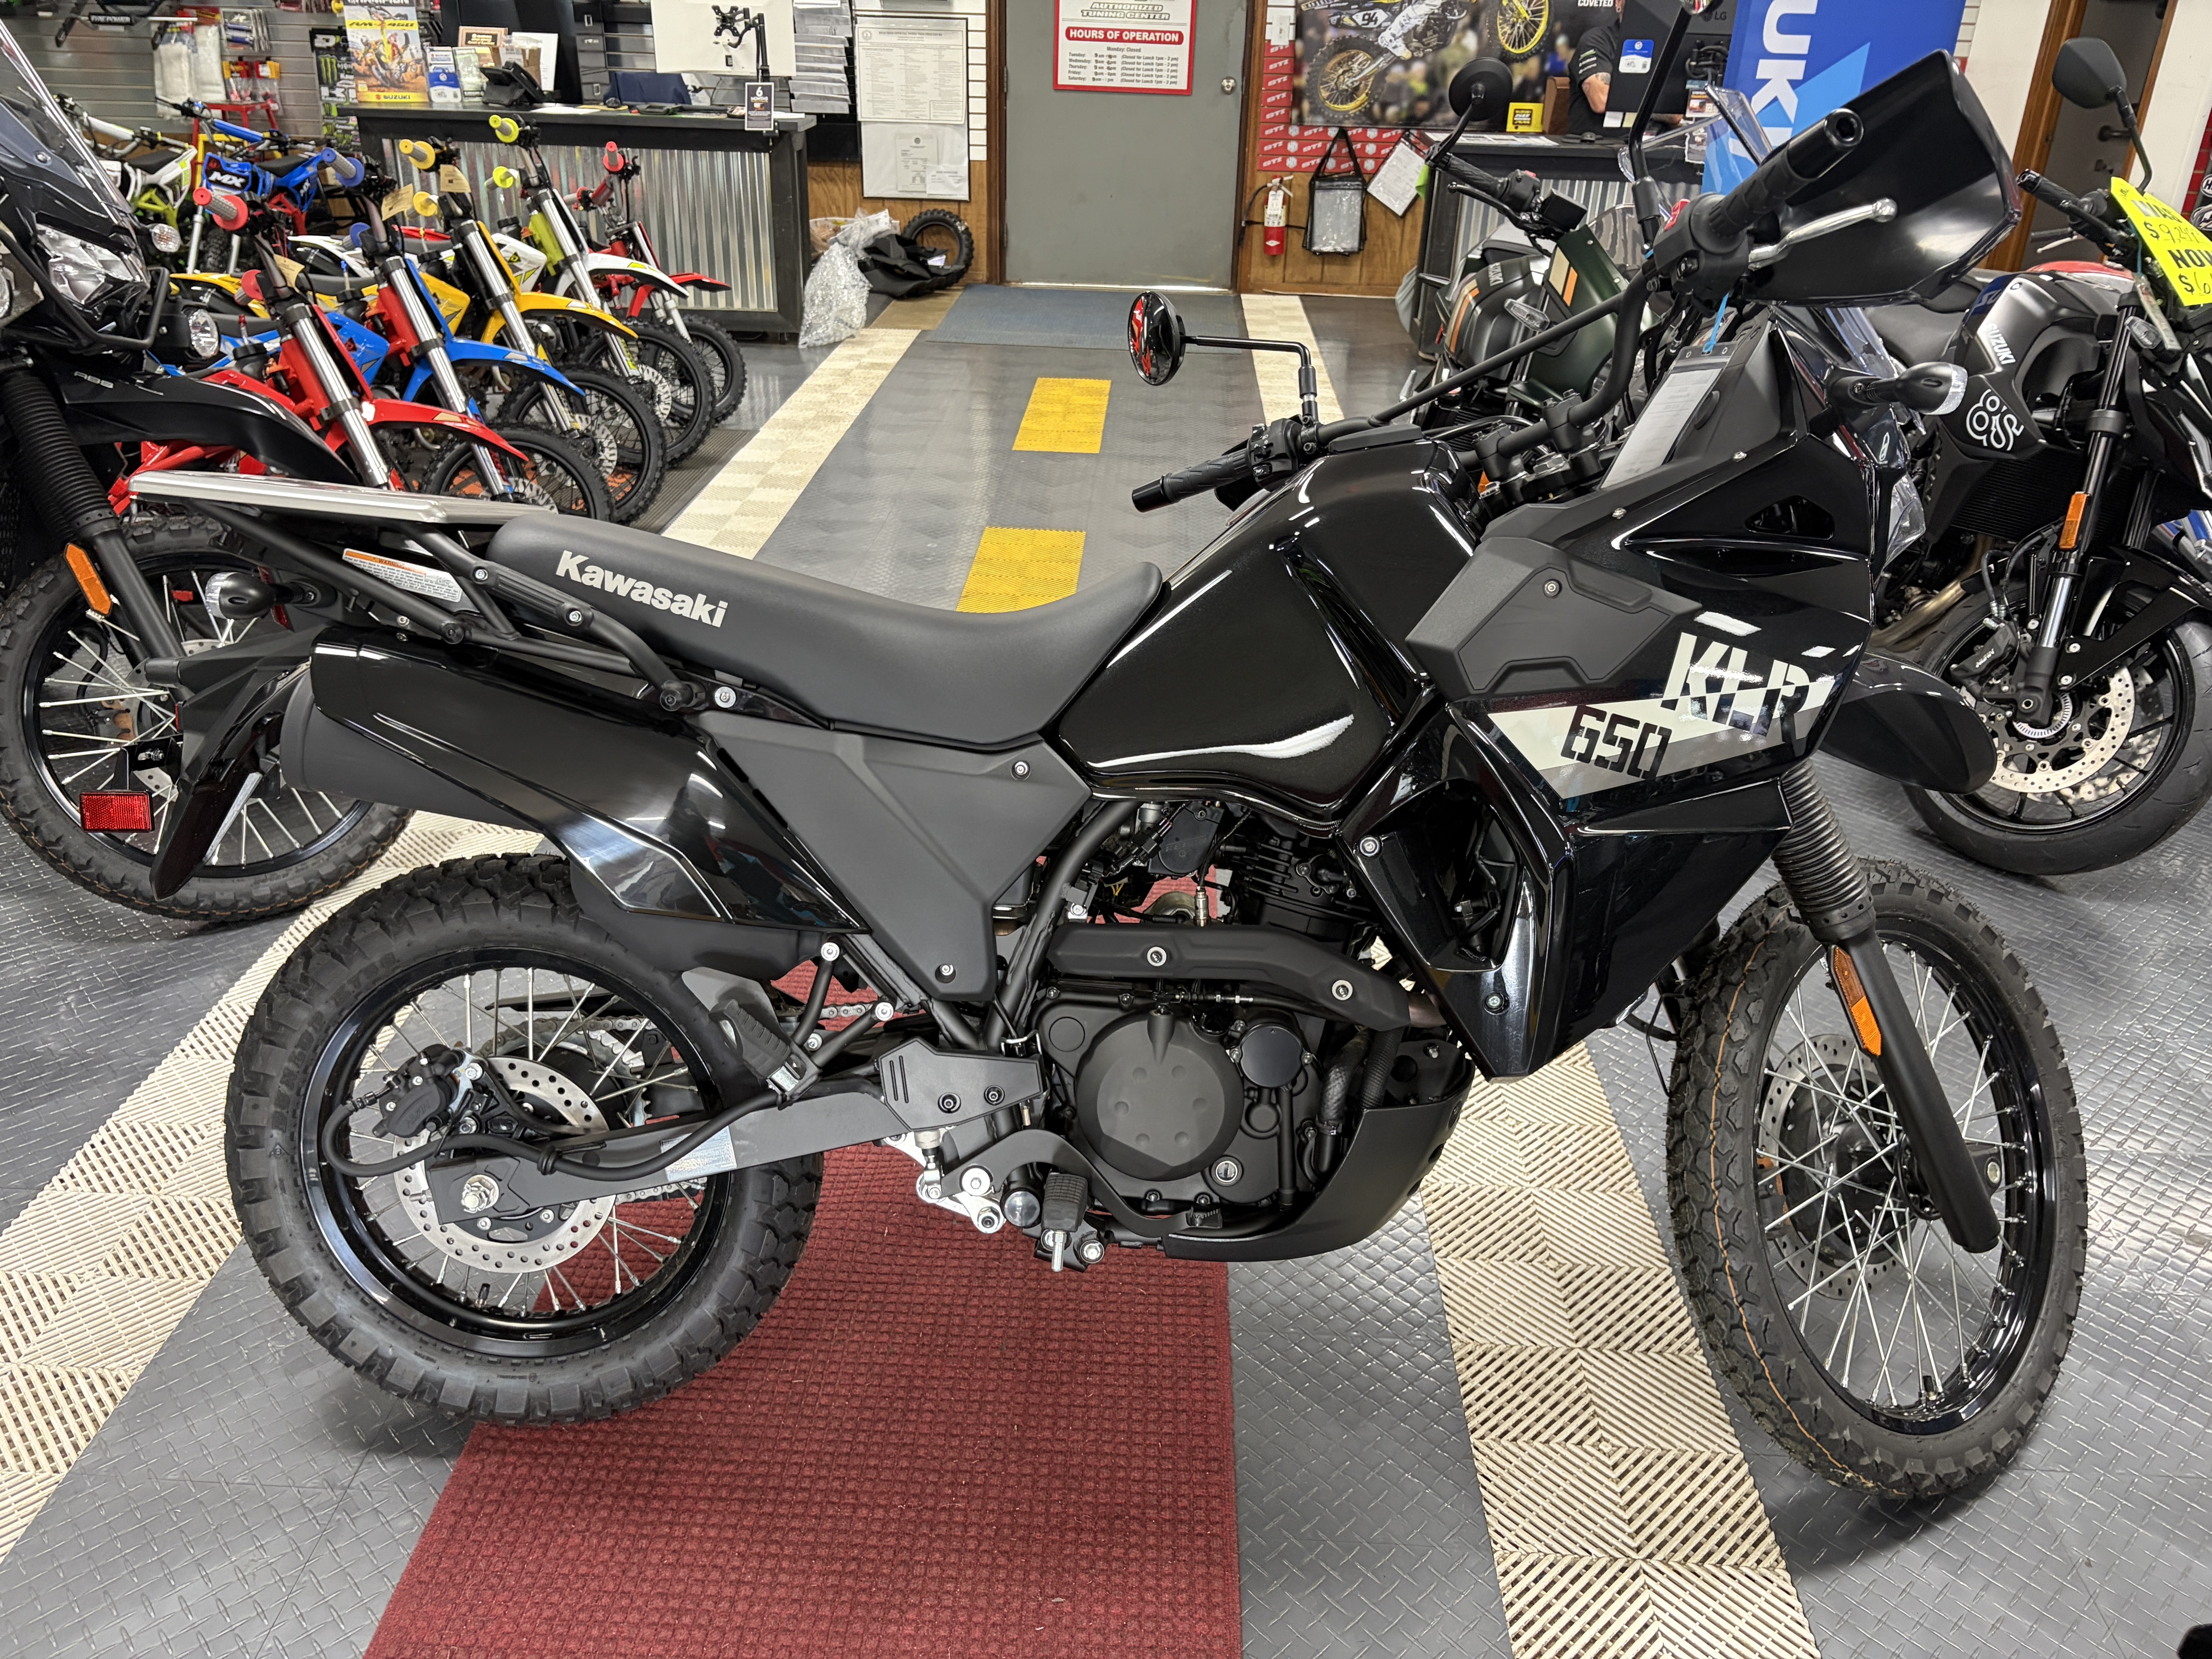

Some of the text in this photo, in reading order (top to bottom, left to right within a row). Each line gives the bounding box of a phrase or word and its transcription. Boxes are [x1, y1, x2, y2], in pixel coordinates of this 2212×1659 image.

[1082, 10, 1125, 18] TUNING
[1091, 2, 1163, 11] AUTHORIZED
[1362, 12, 1378, 26] 94
[1714, 12, 1727, 20] LG
[1070, 29, 1179, 42] HOURS OF OPERATION
[756, 86, 763, 97] 6
[209, 171, 246, 187] MX
[2131, 199, 2183, 223] WAS
[1985, 323, 2016, 365] SUZUKI
[74, 371, 114, 389] ABS
[555, 550, 728, 628] Kawasaki
[1660, 632, 1810, 744] KLR
[1561, 705, 1673, 780] 650
